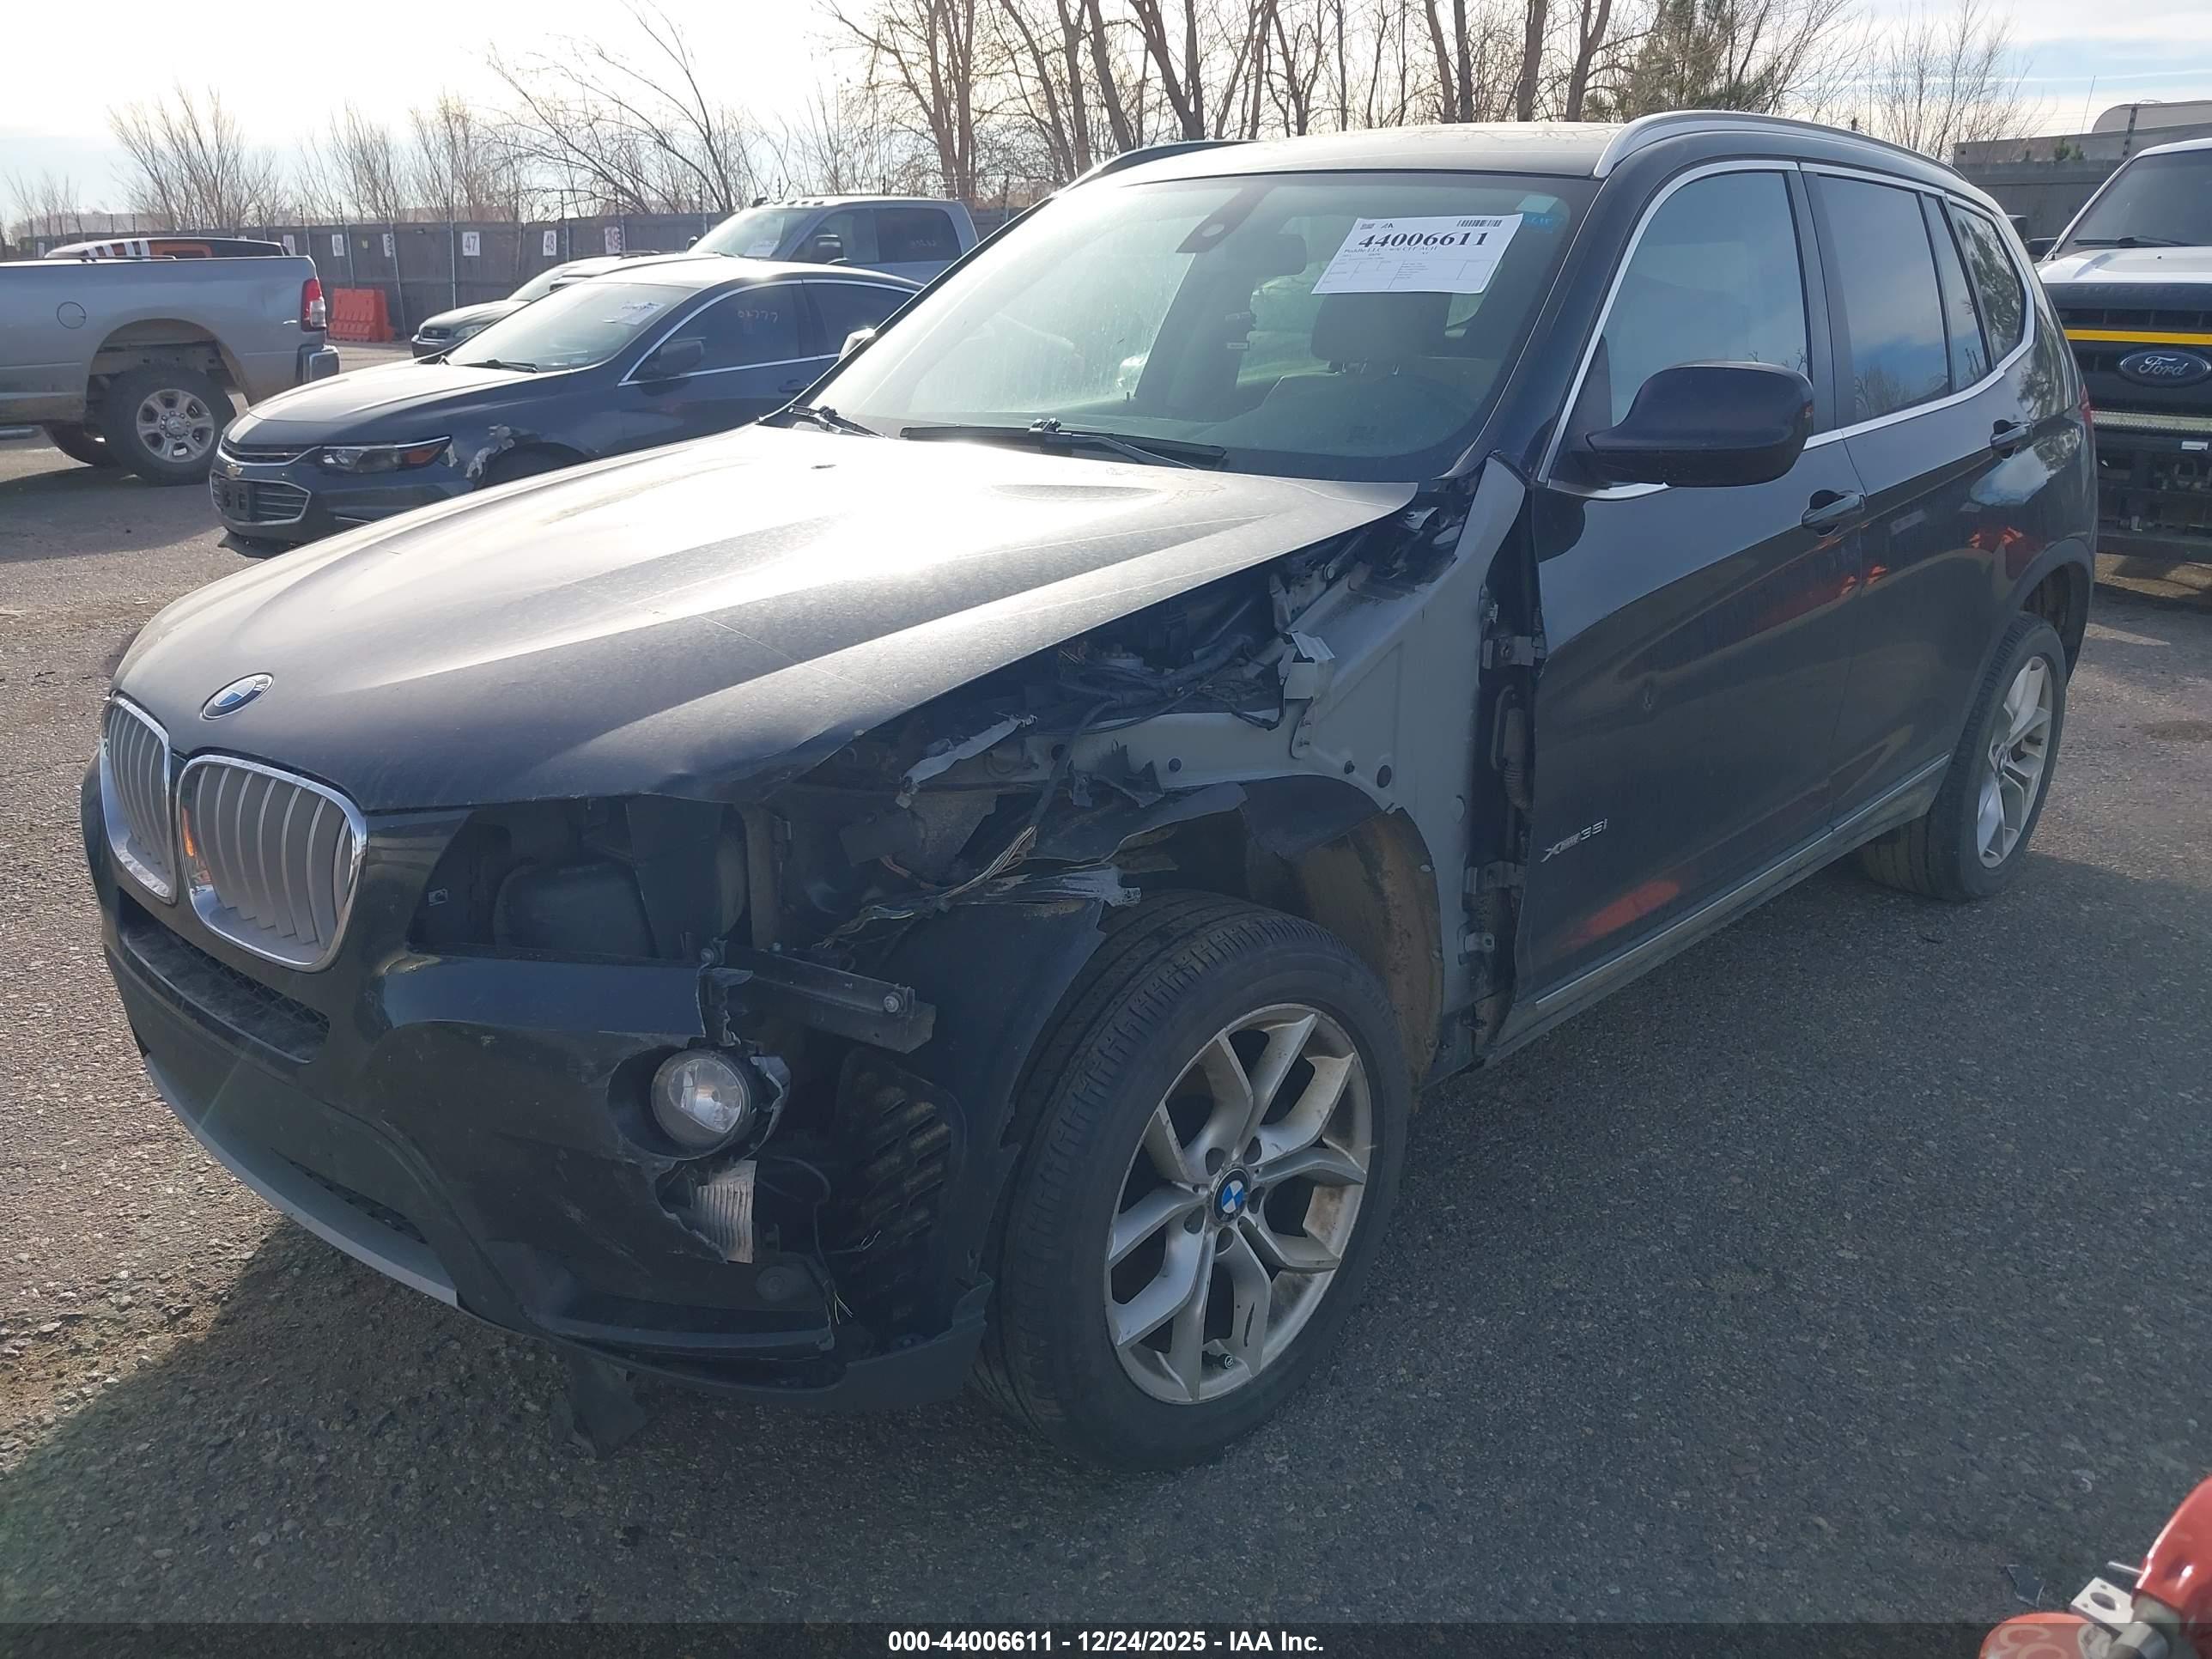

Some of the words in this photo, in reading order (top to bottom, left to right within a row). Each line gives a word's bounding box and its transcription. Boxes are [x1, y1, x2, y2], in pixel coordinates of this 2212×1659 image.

[465, 235, 477, 252] 47
[544, 234, 556, 252] 48
[1358, 231, 1489, 248] 44006611
[2138, 356, 2189, 376] Ford
